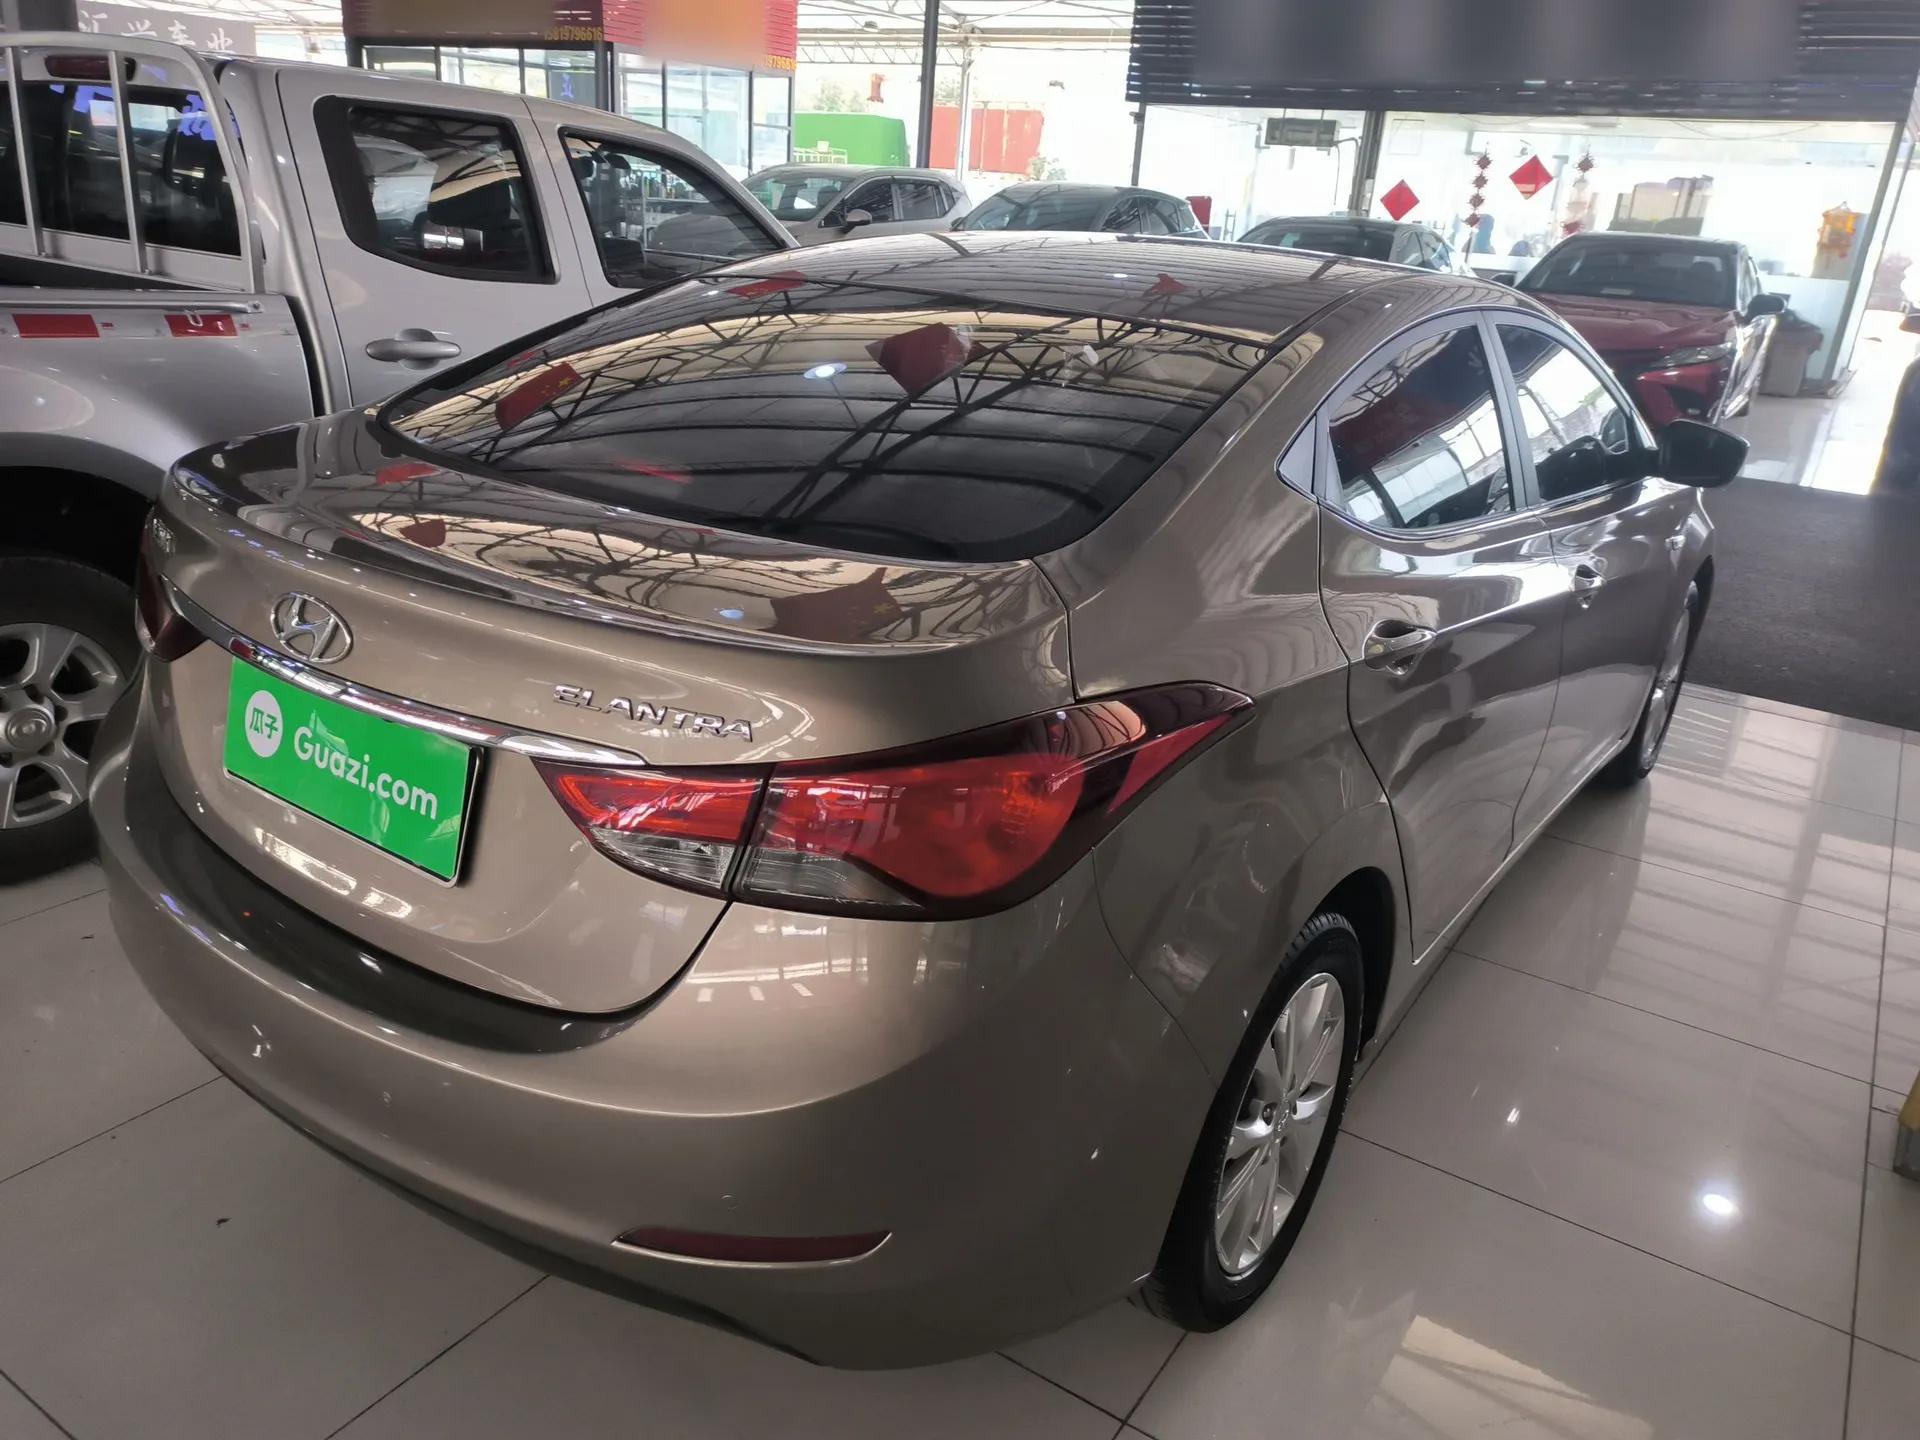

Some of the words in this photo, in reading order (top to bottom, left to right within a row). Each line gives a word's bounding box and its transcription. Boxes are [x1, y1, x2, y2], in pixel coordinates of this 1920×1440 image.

[249, 707, 279, 739] 瓜子
[552, 684, 754, 743] ELANTRA
[294, 726, 438, 821] Guazi.com
